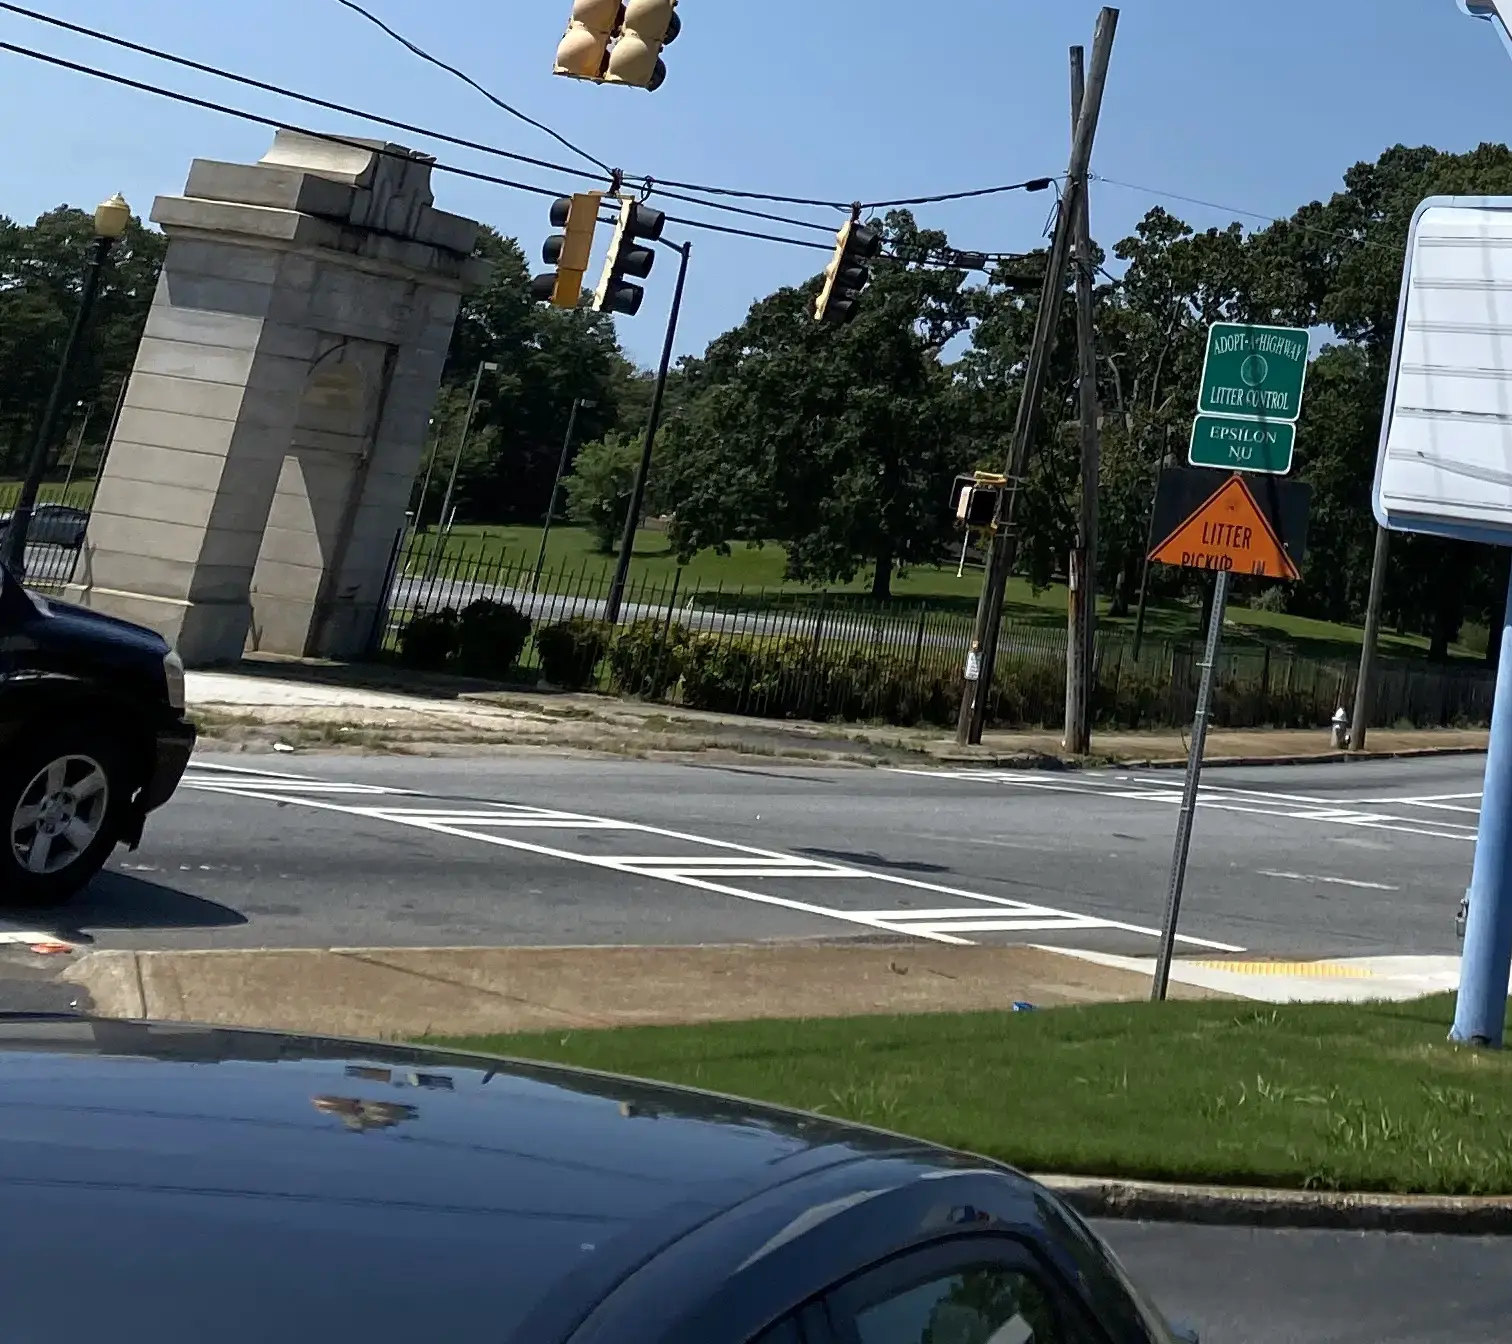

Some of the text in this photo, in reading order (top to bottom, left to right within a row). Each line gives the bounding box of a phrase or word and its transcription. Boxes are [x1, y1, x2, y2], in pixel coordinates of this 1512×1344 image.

[1210, 386, 1289, 410] LITTER CONTROL
[1210, 425, 1277, 444] EPSILON
[1228, 445, 1253, 460] NU
[1202, 521, 1252, 550] LITTER
